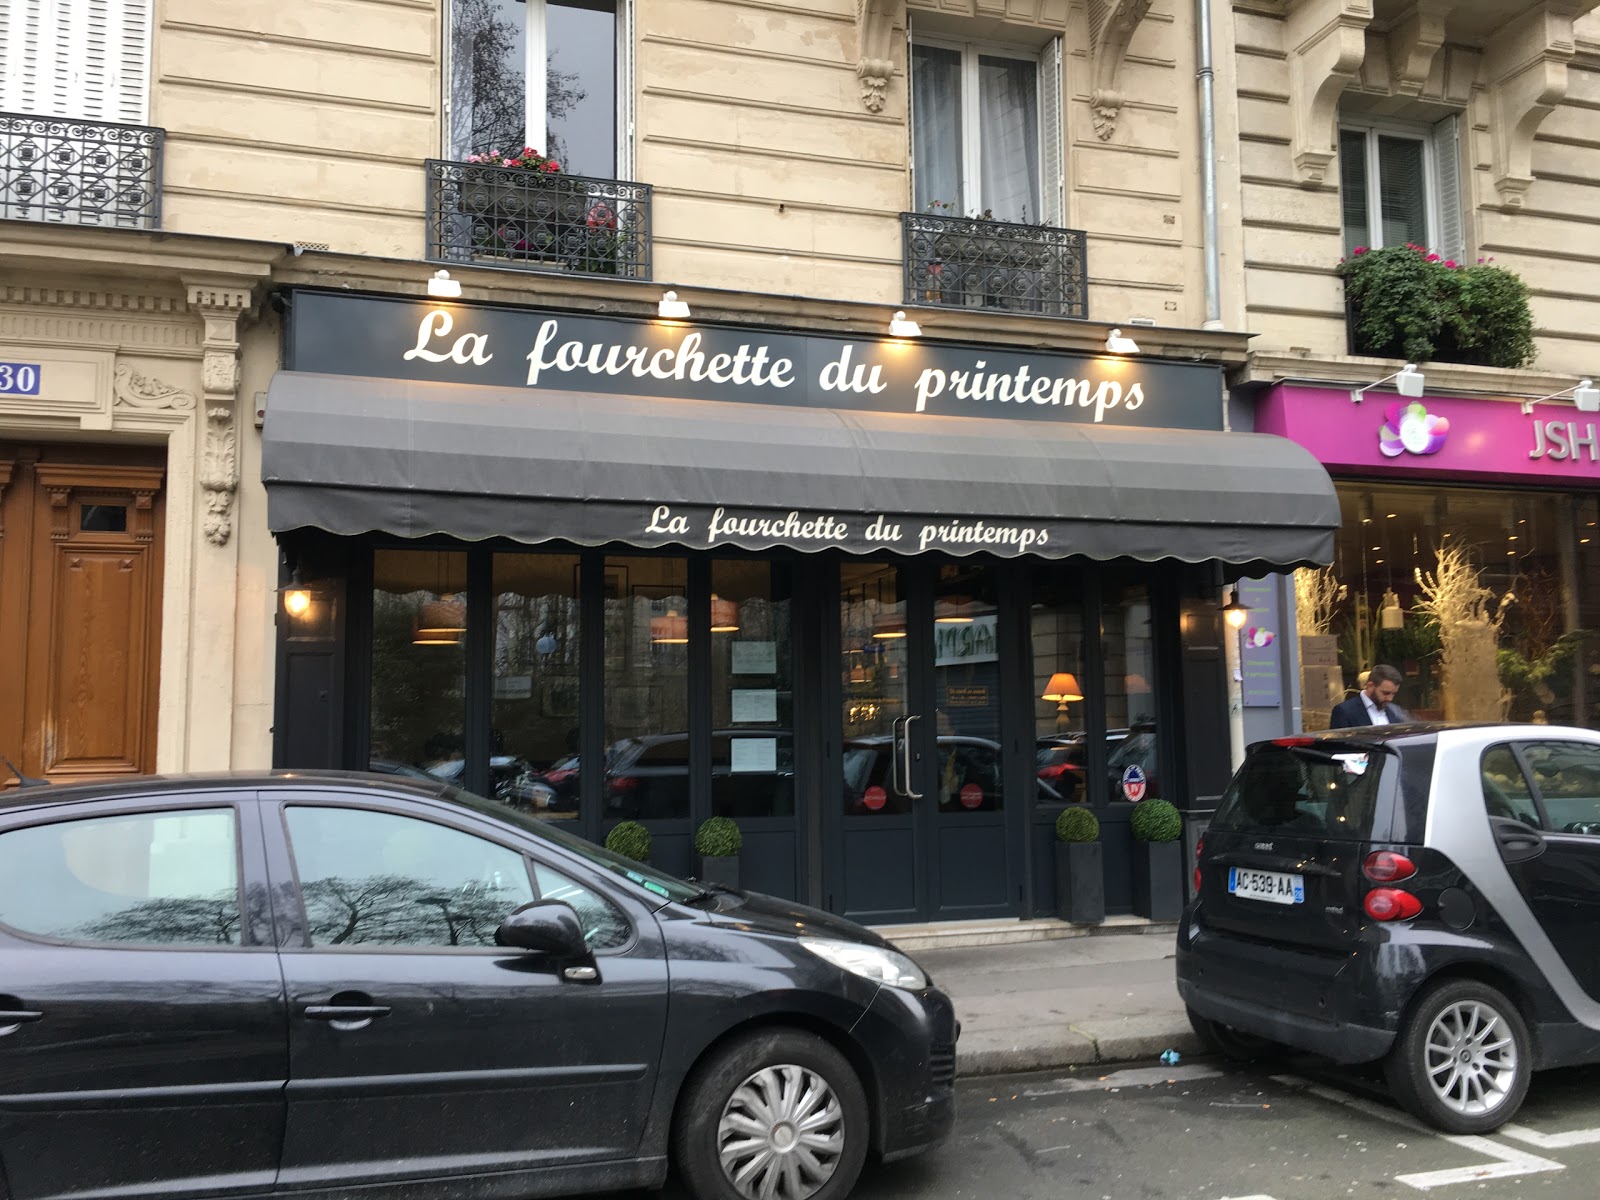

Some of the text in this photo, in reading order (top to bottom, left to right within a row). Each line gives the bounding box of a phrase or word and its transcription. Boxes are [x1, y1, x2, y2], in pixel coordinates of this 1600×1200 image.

[0, 365, 36, 392] 30
[403, 309, 1145, 423] La fourchette du printemps
[644, 505, 1049, 554] La fourchette du printemps
[1236, 871, 1294, 897] AC-539-AA
